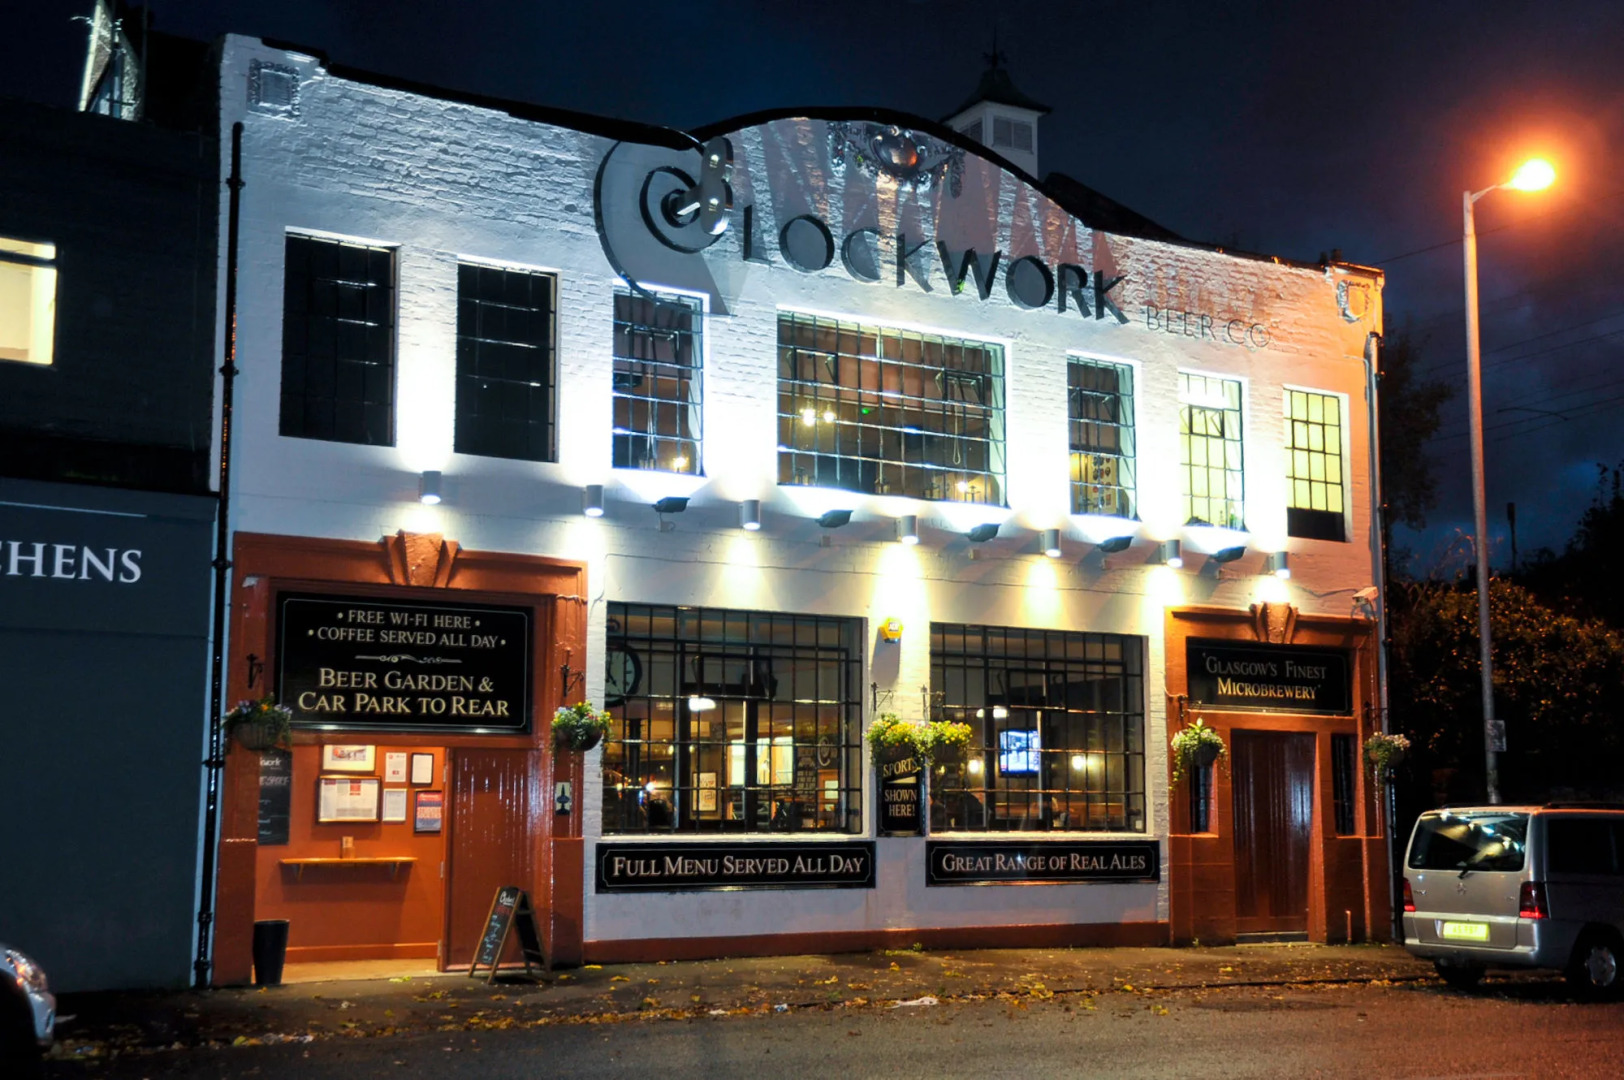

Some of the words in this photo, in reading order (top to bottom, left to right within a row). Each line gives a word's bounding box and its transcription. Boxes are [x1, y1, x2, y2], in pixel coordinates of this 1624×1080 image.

[593, 136, 1129, 325] CLOCKWORK
[1146, 304, 1217, 341] BEER
[1226, 318, 1271, 348] CO
[0, 540, 142, 583] HENS
[347, 609, 386, 625] FREE
[390, 611, 428, 627] WI-FI
[433, 615, 472, 629] HERE
[317, 626, 376, 643] COFFEE
[379, 629, 436, 646] SERVED
[439, 632, 468, 647] ALL
[470, 634, 499, 649] DAY
[319, 667, 379, 689] BEER
[384, 670, 475, 692] GARDEN
[478, 675, 495, 693] &
[1285, 660, 1327, 680] FINEST
[298, 691, 347, 712] CAR
[354, 692, 412, 714] PARK
[417, 697, 447, 714] TO
[451, 696, 510, 717] REAR
[883, 757, 919, 777] SPORTS
[884, 789, 918, 803] SHOWN
[888, 804, 916, 818] HERE!
[613, 856, 662, 877] FULL
[664, 856, 719, 876] MENU
[723, 855, 790, 875] SERVED
[792, 855, 828, 874] ALL
[830, 854, 865, 874] DAY
[942, 853, 993, 872] GREAT
[994, 853, 1046, 872] RANGE
[1049, 855, 1068, 871] OF
[1070, 853, 1109, 871] REAL
[1110, 853, 1146, 871] ALES
